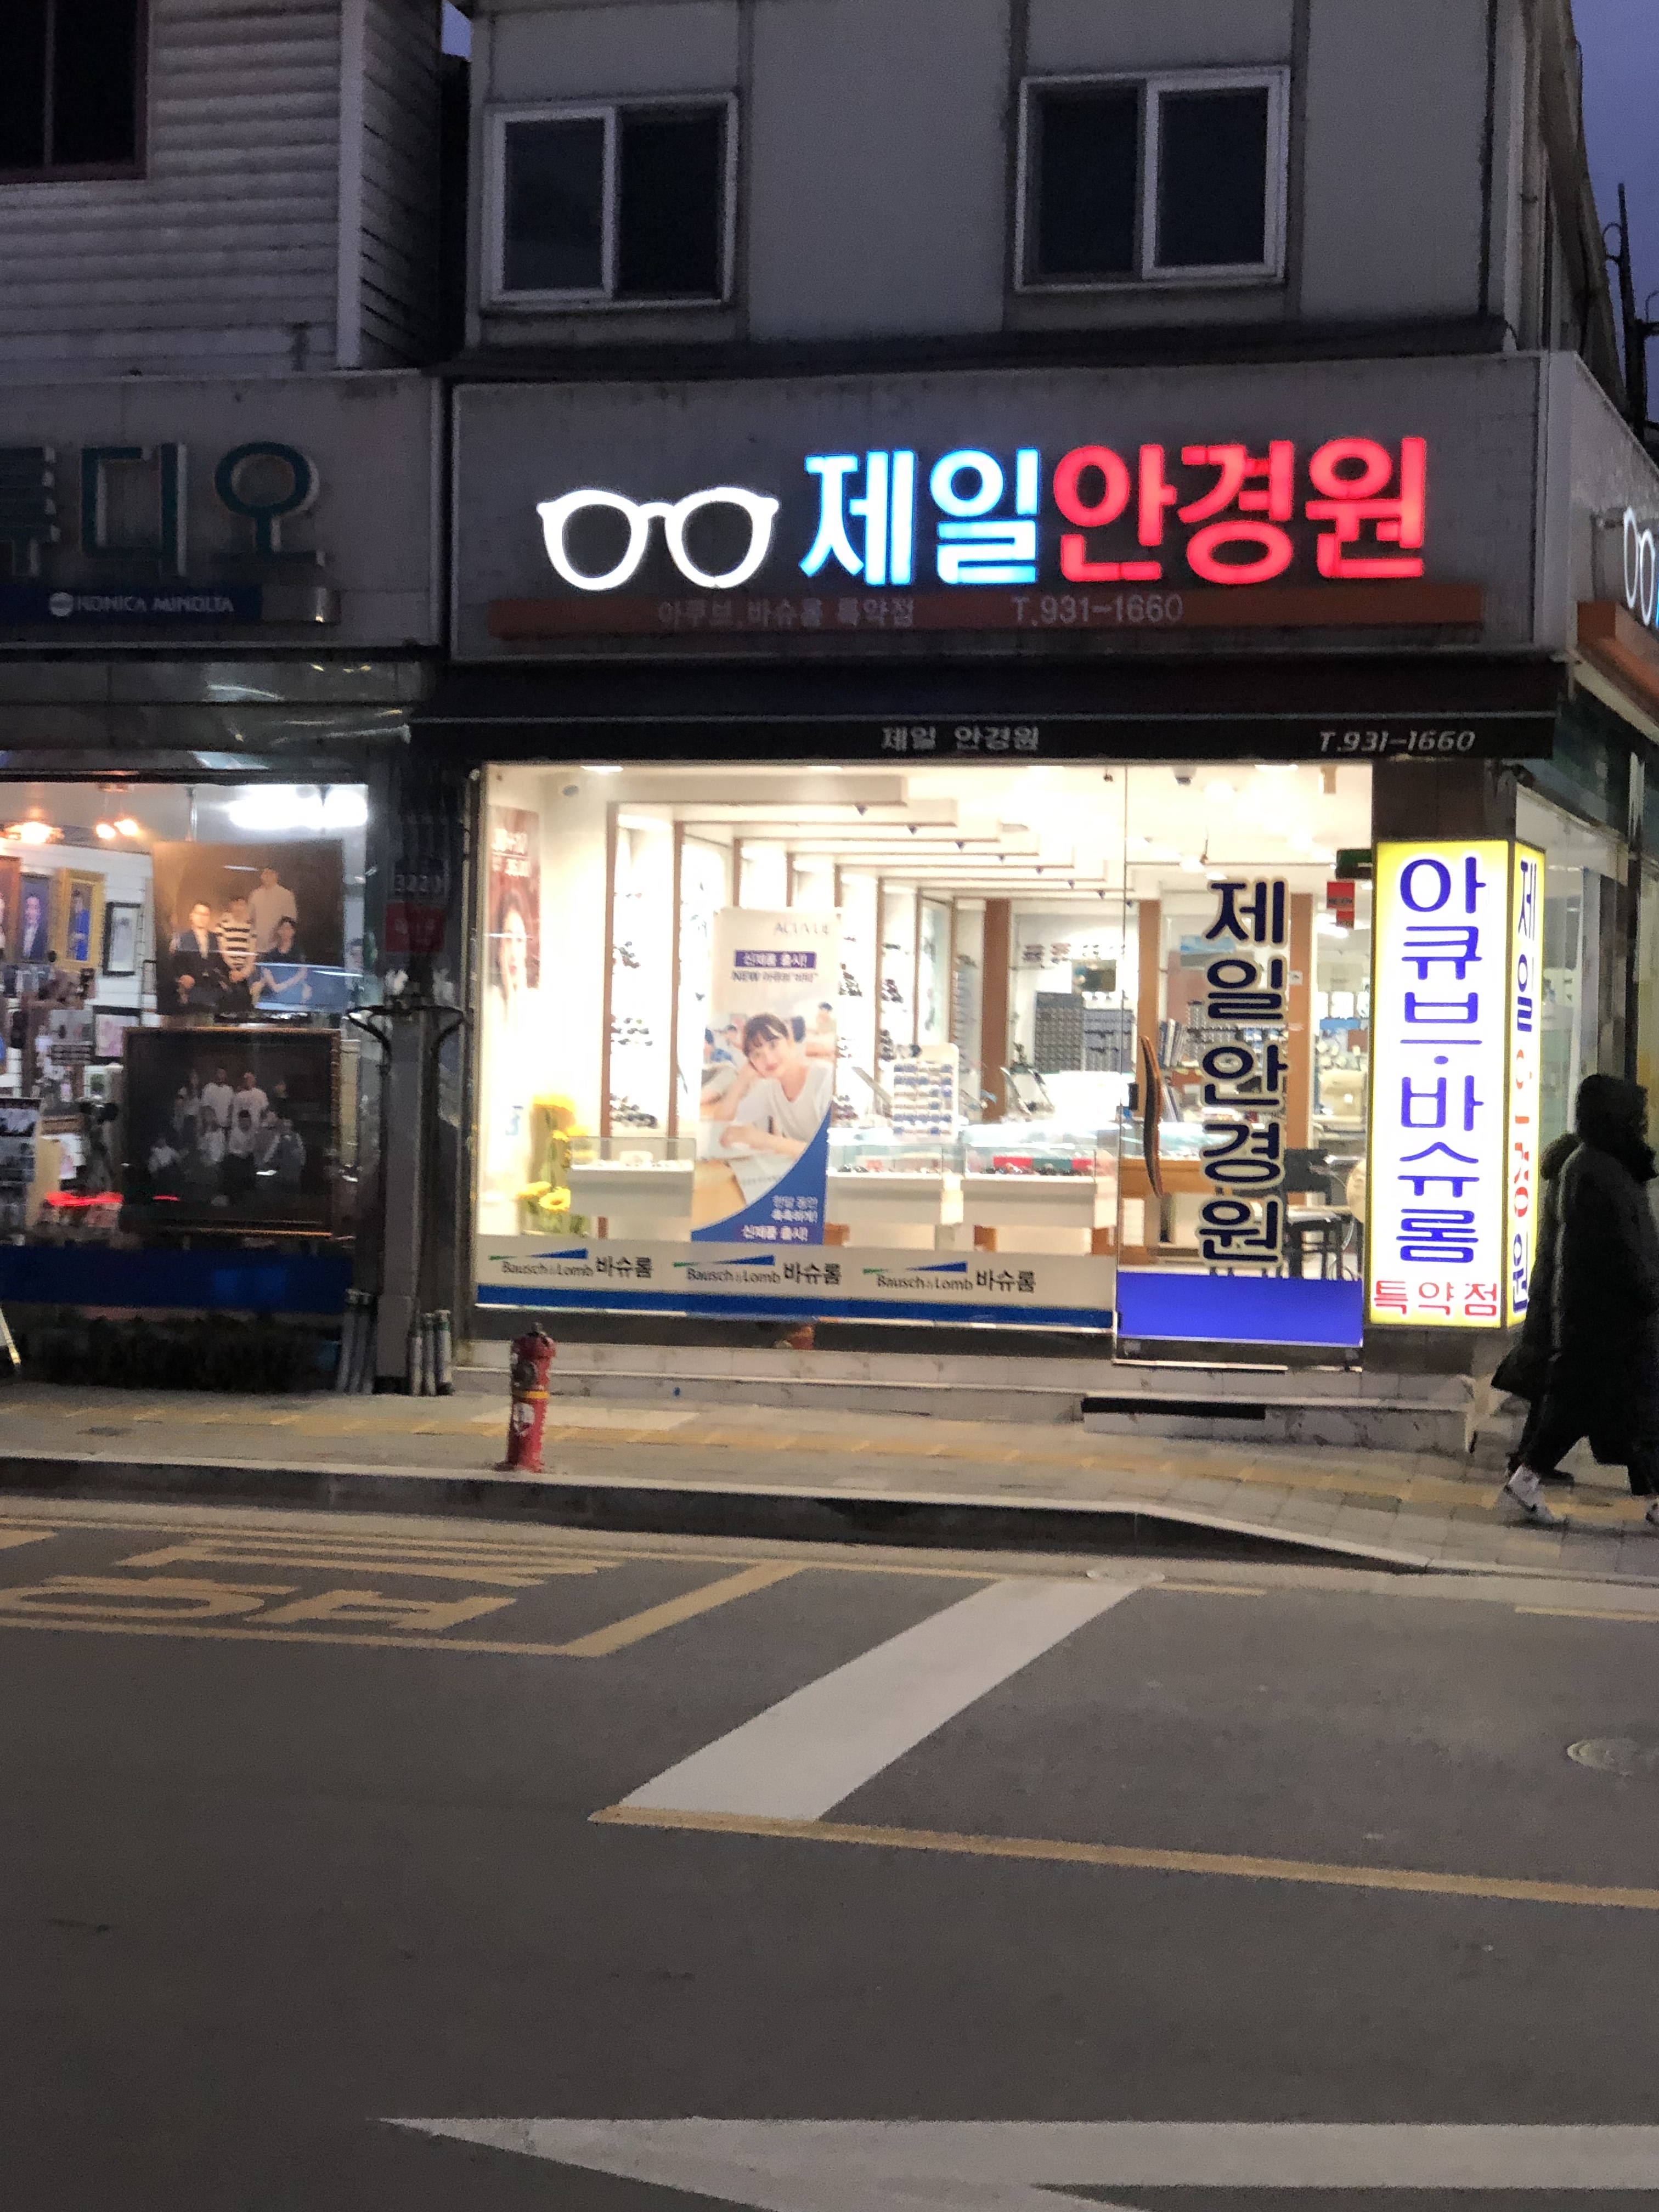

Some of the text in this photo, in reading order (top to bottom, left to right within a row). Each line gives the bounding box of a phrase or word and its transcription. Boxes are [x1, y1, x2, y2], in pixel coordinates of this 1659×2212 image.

[75, 595, 235, 614] KONICA MINOLTA
[837, 597, 914, 628] 특약점
[1011, 593, 1184, 627] T.931-1660
[881, 725, 1039, 752] 제일 안경원
[1319, 729, 1476, 753] T.931-1660
[1200, 880, 1288, 1262] 제일안경원
[596, 1255, 653, 1279] 바슈롬
[783, 1261, 842, 1285] 바슈롬
[976, 1269, 1035, 1294] 바슈롬
[1374, 1280, 1497, 1316] 특약점
